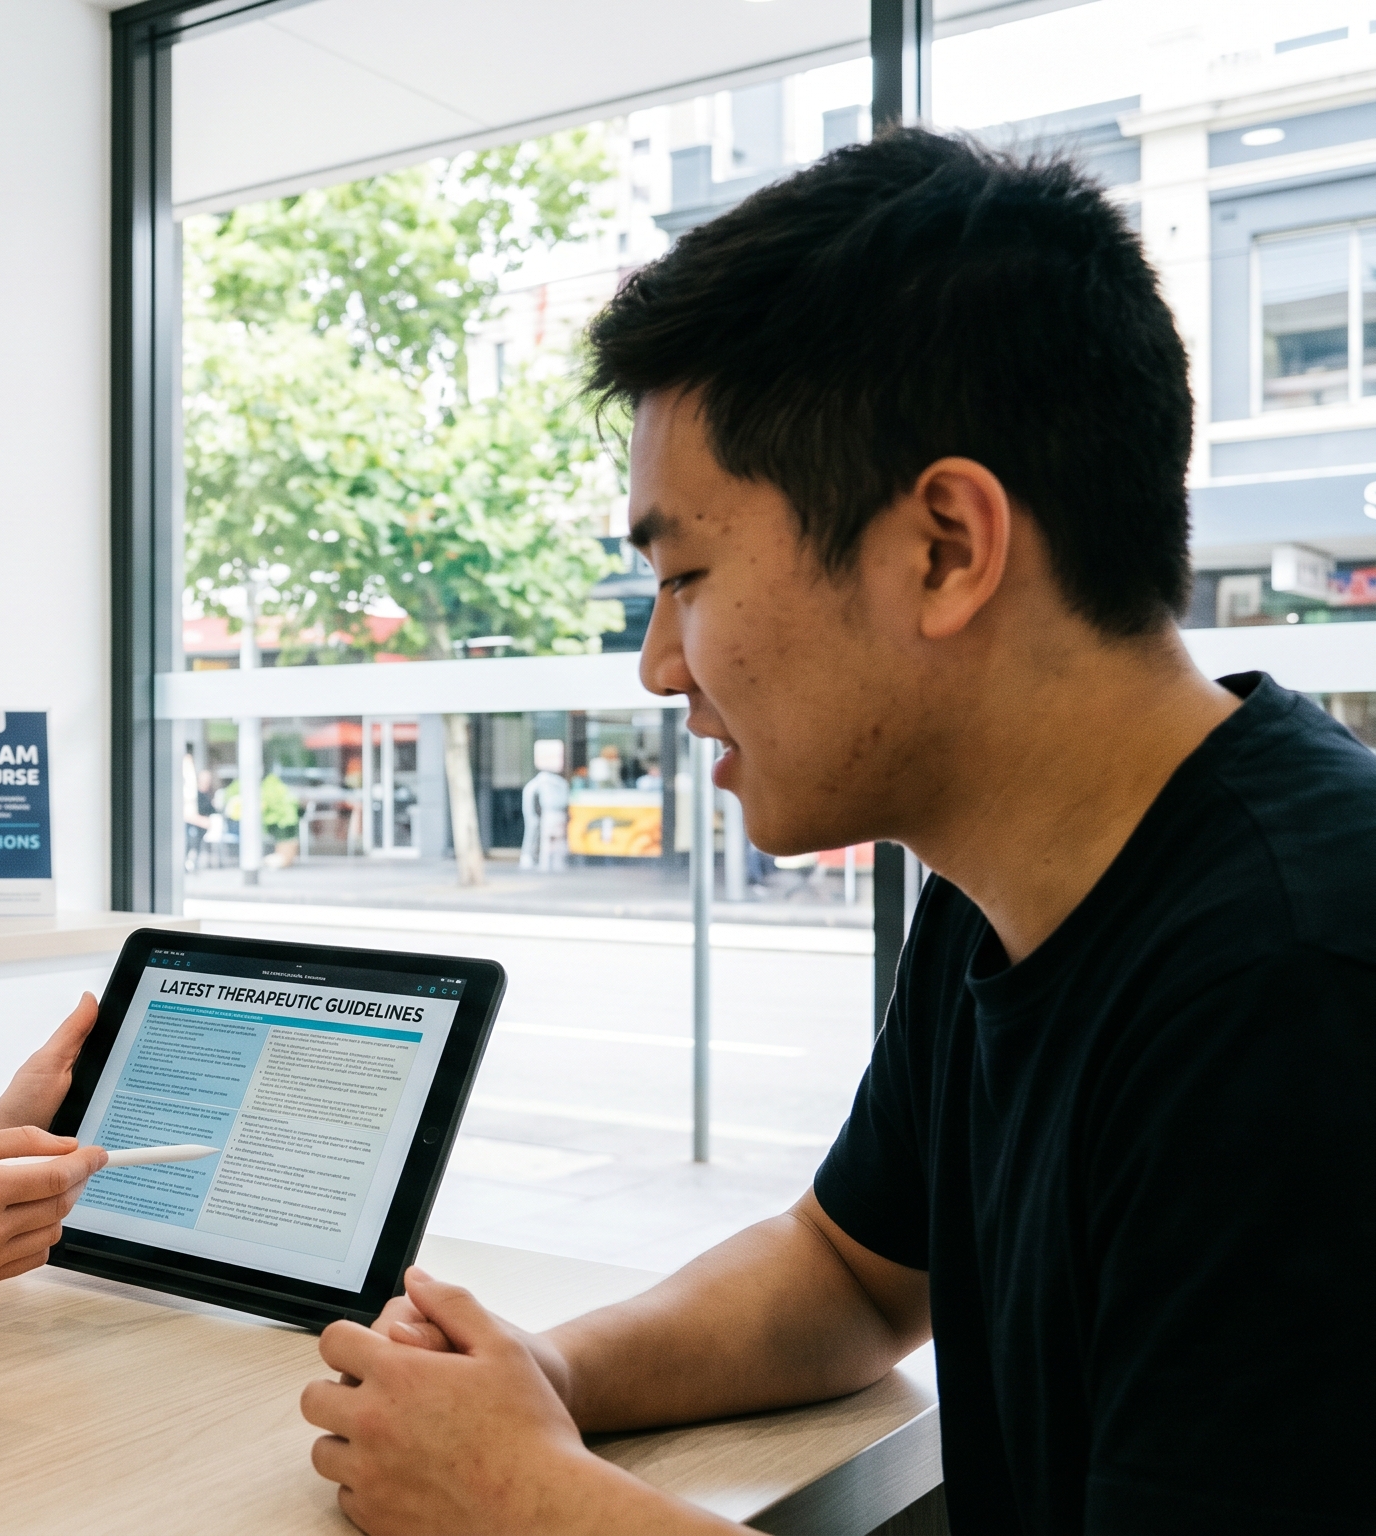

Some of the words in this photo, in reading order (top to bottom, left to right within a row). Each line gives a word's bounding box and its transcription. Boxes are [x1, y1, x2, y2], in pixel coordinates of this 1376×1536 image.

[159, 979, 215, 998] LATEST
[216, 984, 324, 1011] THERAPEUTIC
[324, 997, 425, 1024] GUIDELINES
